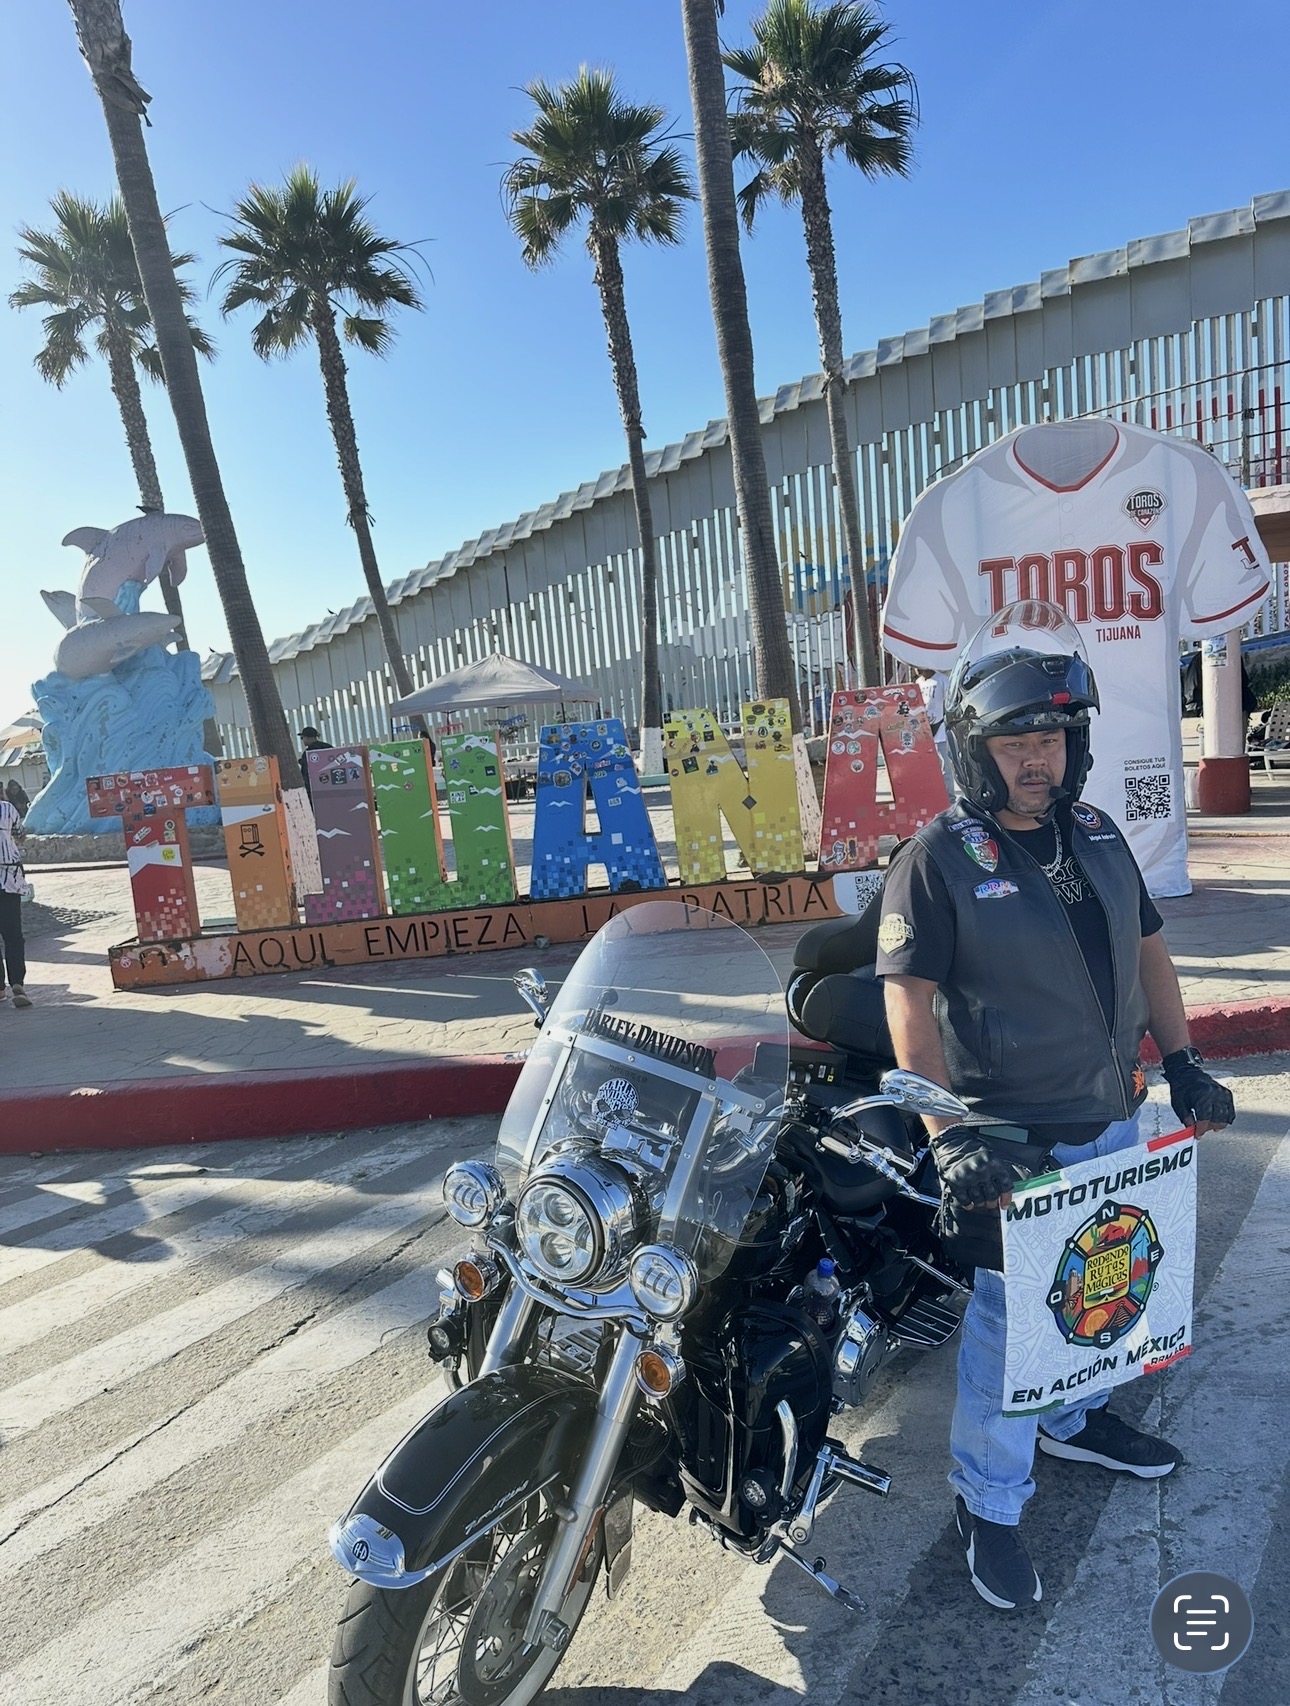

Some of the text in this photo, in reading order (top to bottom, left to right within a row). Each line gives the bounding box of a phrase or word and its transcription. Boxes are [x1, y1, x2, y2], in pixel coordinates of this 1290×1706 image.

[1130, 494, 1159, 509] TOROS
[978, 540, 1165, 638] TOROS
[1096, 626, 1141, 643] TIJUANA
[85, 683, 951, 942] TIJUANA
[231, 881, 830, 971] AQUI EMPIEZA LA PATRIA
[1006, 1145, 1195, 1223] MOTOTURISMO
[1102, 1207, 1116, 1220] N
[1151, 1249, 1160, 1262] E
[1100, 1331, 1112, 1343] S
[1011, 1325, 1186, 1404] EN ACCIÓN MÉXICO
[353, 1542, 368, 1559] H-D
